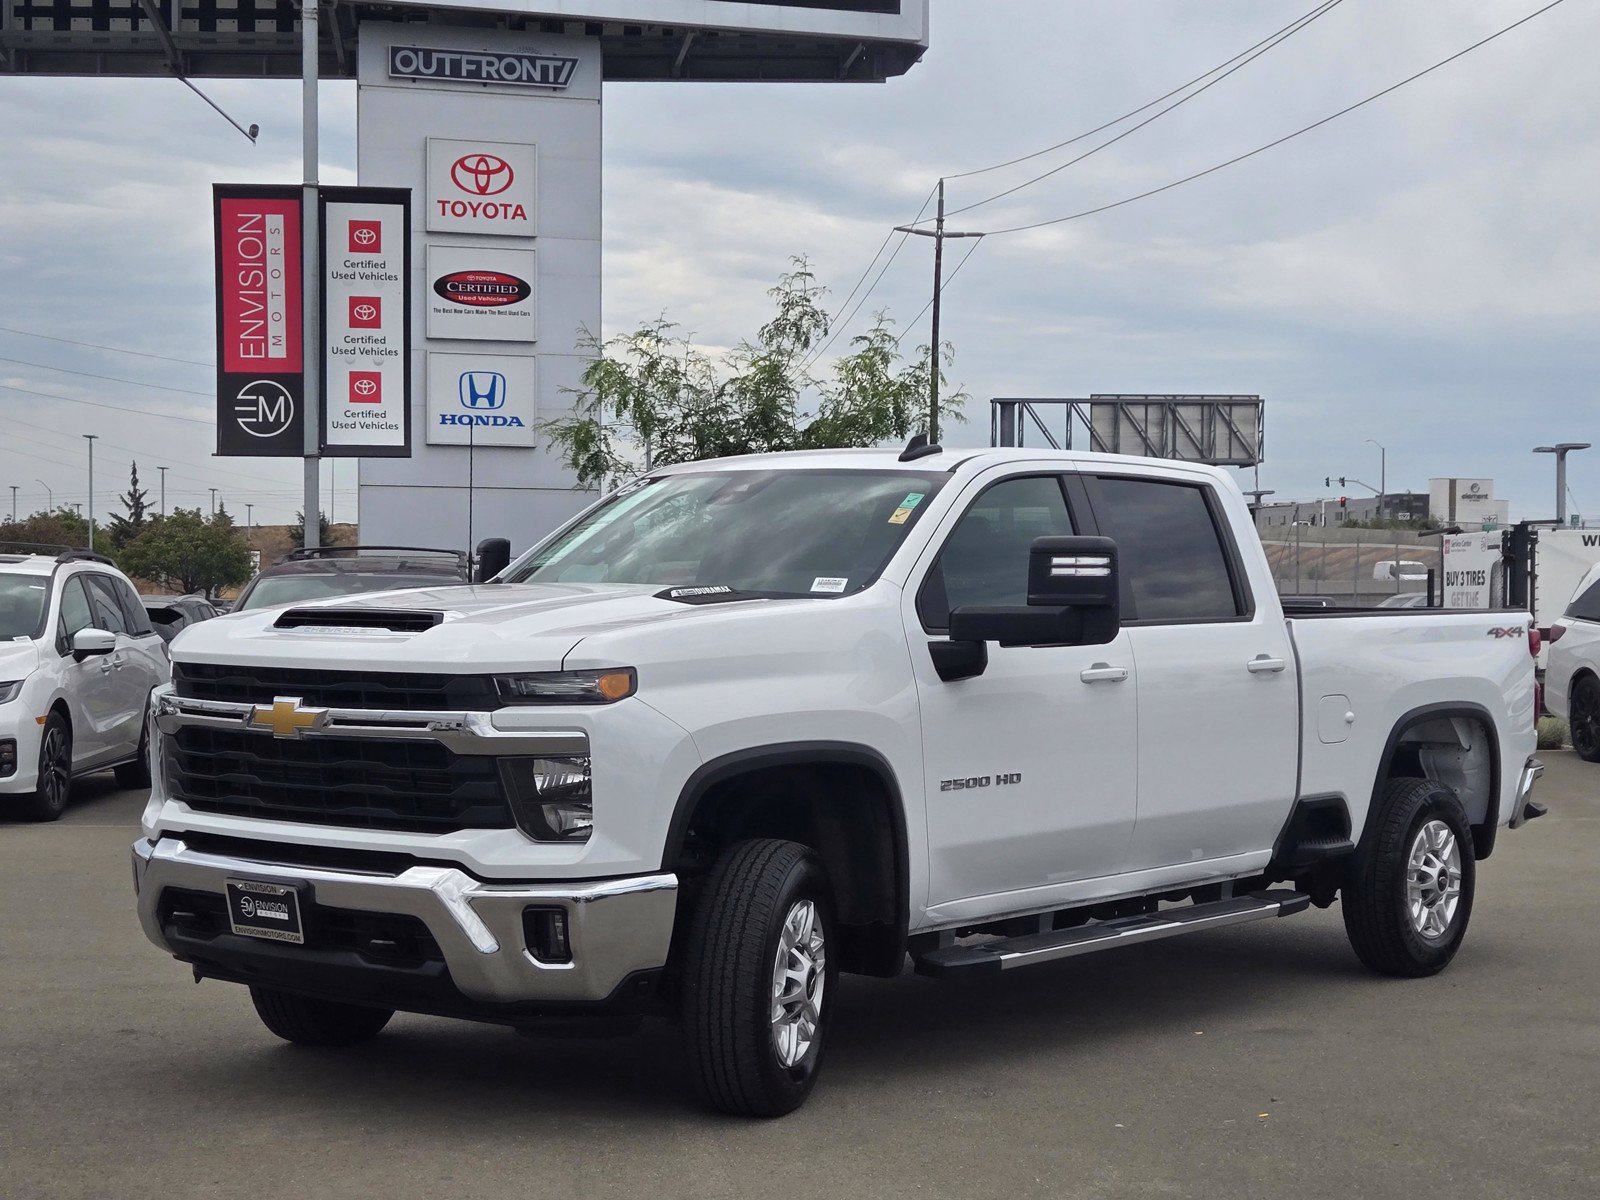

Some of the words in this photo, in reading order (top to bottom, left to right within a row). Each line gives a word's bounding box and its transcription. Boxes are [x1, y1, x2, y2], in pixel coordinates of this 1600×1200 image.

[437, 200, 527, 221] TOYOTA
[344, 260, 386, 269] Certified
[332, 271, 356, 280] Used
[359, 272, 399, 281] Vehicles
[238, 213, 265, 358] ENVISION
[270, 227, 282, 346] MOTORS
[344, 335, 386, 344] Certified
[332, 346, 356, 355] Used
[359, 347, 399, 356] Vehicles
[344, 410, 386, 419] Certified
[332, 421, 356, 429] Used
[359, 422, 399, 430] Vehicles
[439, 414, 525, 427] HONDA
[1582, 535, 1600, 546] W
[1446, 571, 1459, 586] BUY
[1460, 571, 1465, 586] 3
[1466, 570, 1485, 586] TIRES
[695, 586, 732, 595] DURAMAX
[1451, 592, 1463, 607] GET
[304, 626, 377, 634] CHEVROLET
[941, 776, 991, 792] 2500
[996, 773, 1021, 786] HD
[244, 882, 277, 893] ENVISION
[255, 900, 288, 912] ENVISION
[235, 926, 301, 941] ENVISIONMOTORS.COM
